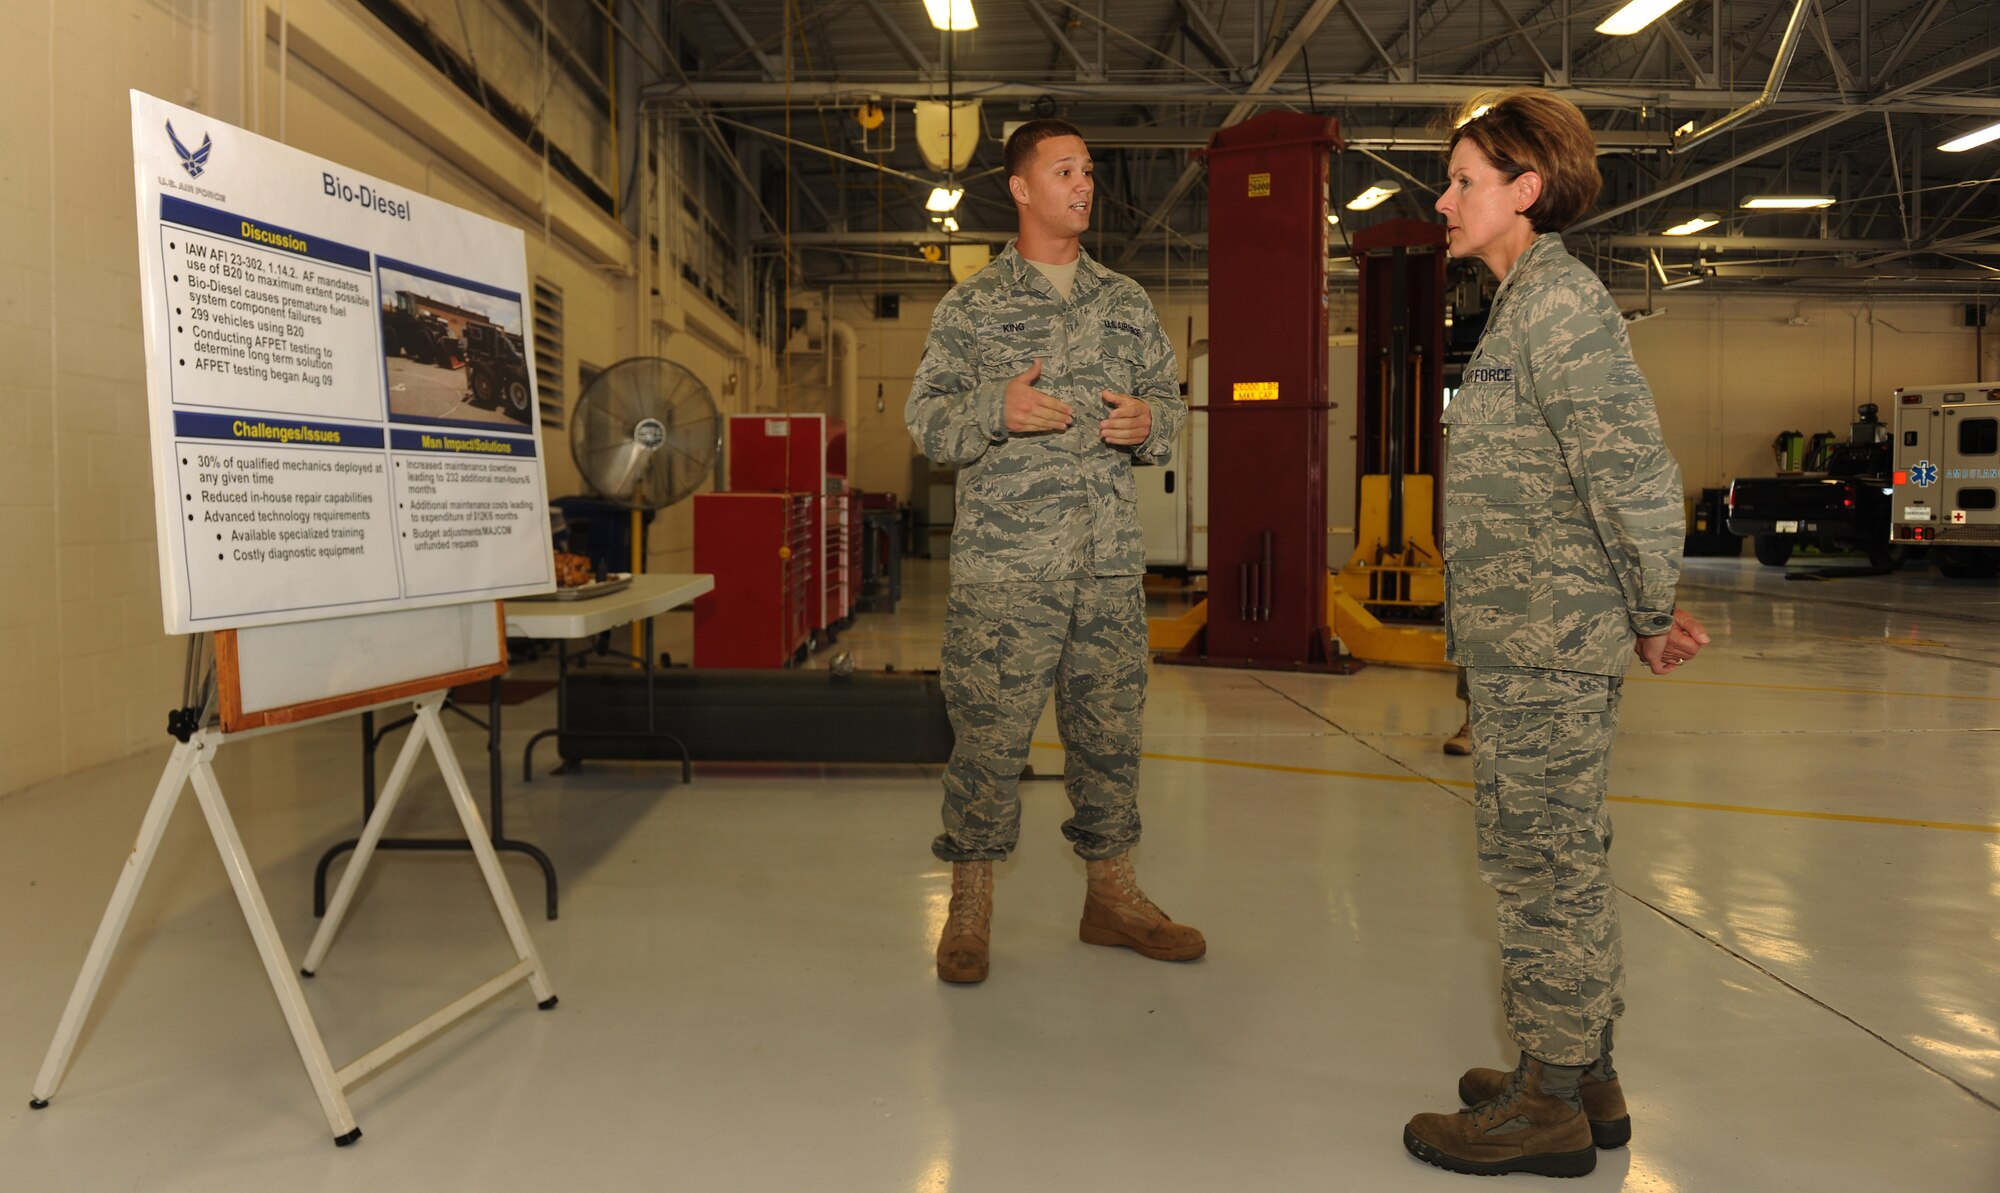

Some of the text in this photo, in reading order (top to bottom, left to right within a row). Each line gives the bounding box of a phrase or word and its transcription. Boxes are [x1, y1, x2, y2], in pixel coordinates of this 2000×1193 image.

[158, 176, 226, 202] U.S. AIR FORCE
[322, 172, 410, 221] Bio-Diesel
[241, 221, 306, 252] Discussion
[186, 242, 206, 258] IAW
[210, 250, 228, 263] AFI
[230, 253, 265, 272] 23-302,
[303, 270, 314, 282] AF
[317, 275, 359, 292] mandates
[186, 260, 370, 307] use of B20 to maximum extent possible
[188, 275, 346, 317] Bio-Diesel causes premature fuel
[189, 291, 322, 324] system component failures
[191, 307, 304, 338] 299 vehicles using B20
[1003, 323, 1024, 332] KING
[192, 326, 332, 358] Conducting AFPET testing to
[194, 340, 333, 370] determine long term solution
[195, 358, 333, 388] AFPET testing began Aug 09
[1475, 368, 1511, 382] FORCE
[233, 420, 340, 443] Challenges/Issues
[421, 435, 442, 448] Msn
[198, 455, 382, 475] 30% of qualified mechanics deployed at
[406, 460, 442, 470] Increased
[444, 462, 487, 472] maintenance
[199, 472, 274, 486] any given time
[408, 472, 434, 484] leading
[436, 473, 444, 482] to
[460, 473, 492, 483] additional
[202, 490, 373, 504] Reduced in-house repair capabilities
[408, 485, 436, 494] months
[410, 500, 533, 512] Additional maintenance costs leading
[204, 510, 370, 524] Advanced technology requirements
[411, 513, 418, 523] to
[421, 513, 464, 524] expenditure
[466, 512, 473, 521] of
[495, 512, 518, 520] months
[231, 527, 364, 542] Available specialized training
[413, 528, 440, 540] Budget
[415, 540, 478, 551] unfunded requests
[233, 545, 364, 563] Costly diagnostic equipment
